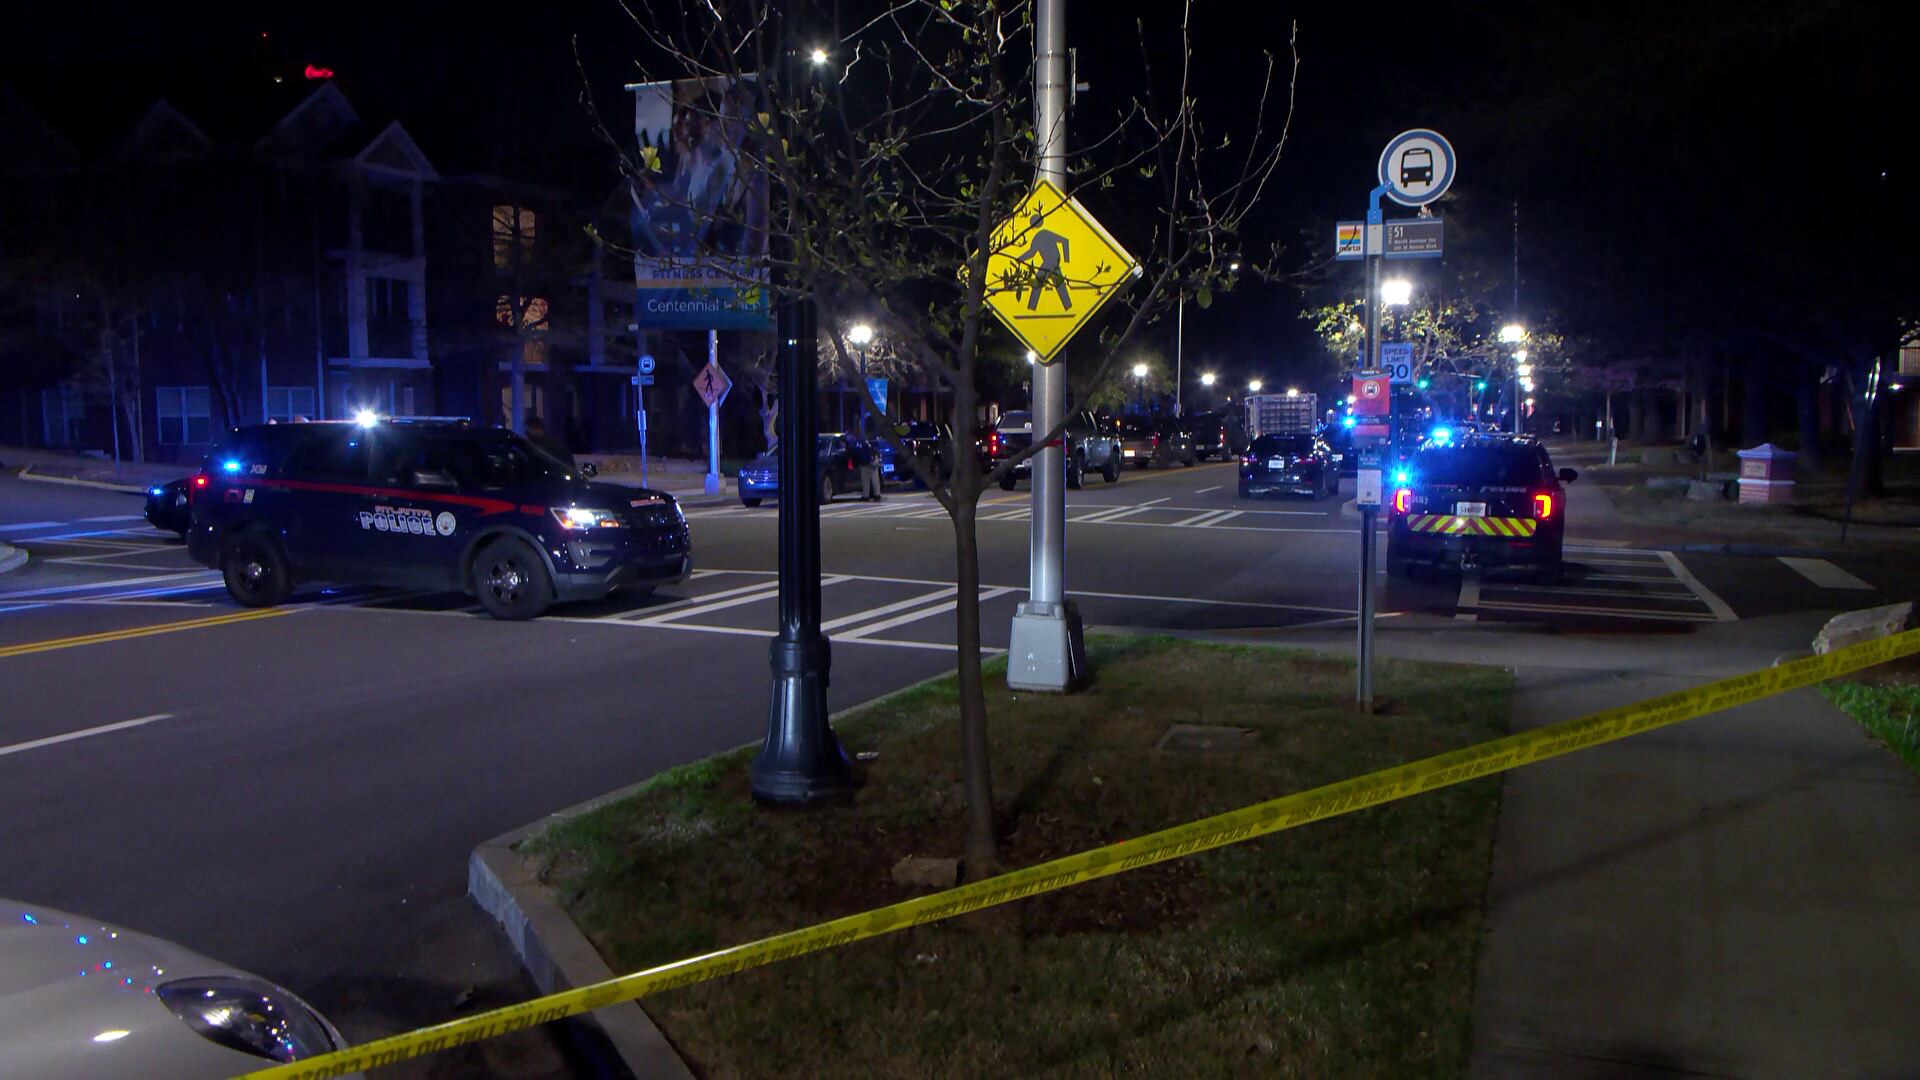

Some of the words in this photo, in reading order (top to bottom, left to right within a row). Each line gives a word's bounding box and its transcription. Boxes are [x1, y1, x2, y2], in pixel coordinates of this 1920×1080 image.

[1394, 226, 1404, 238] 51
[653, 269, 702, 280] FITNESS
[647, 297, 719, 313] Centennial
[1384, 363, 1409, 379] 30
[360, 511, 436, 536] POLICE
